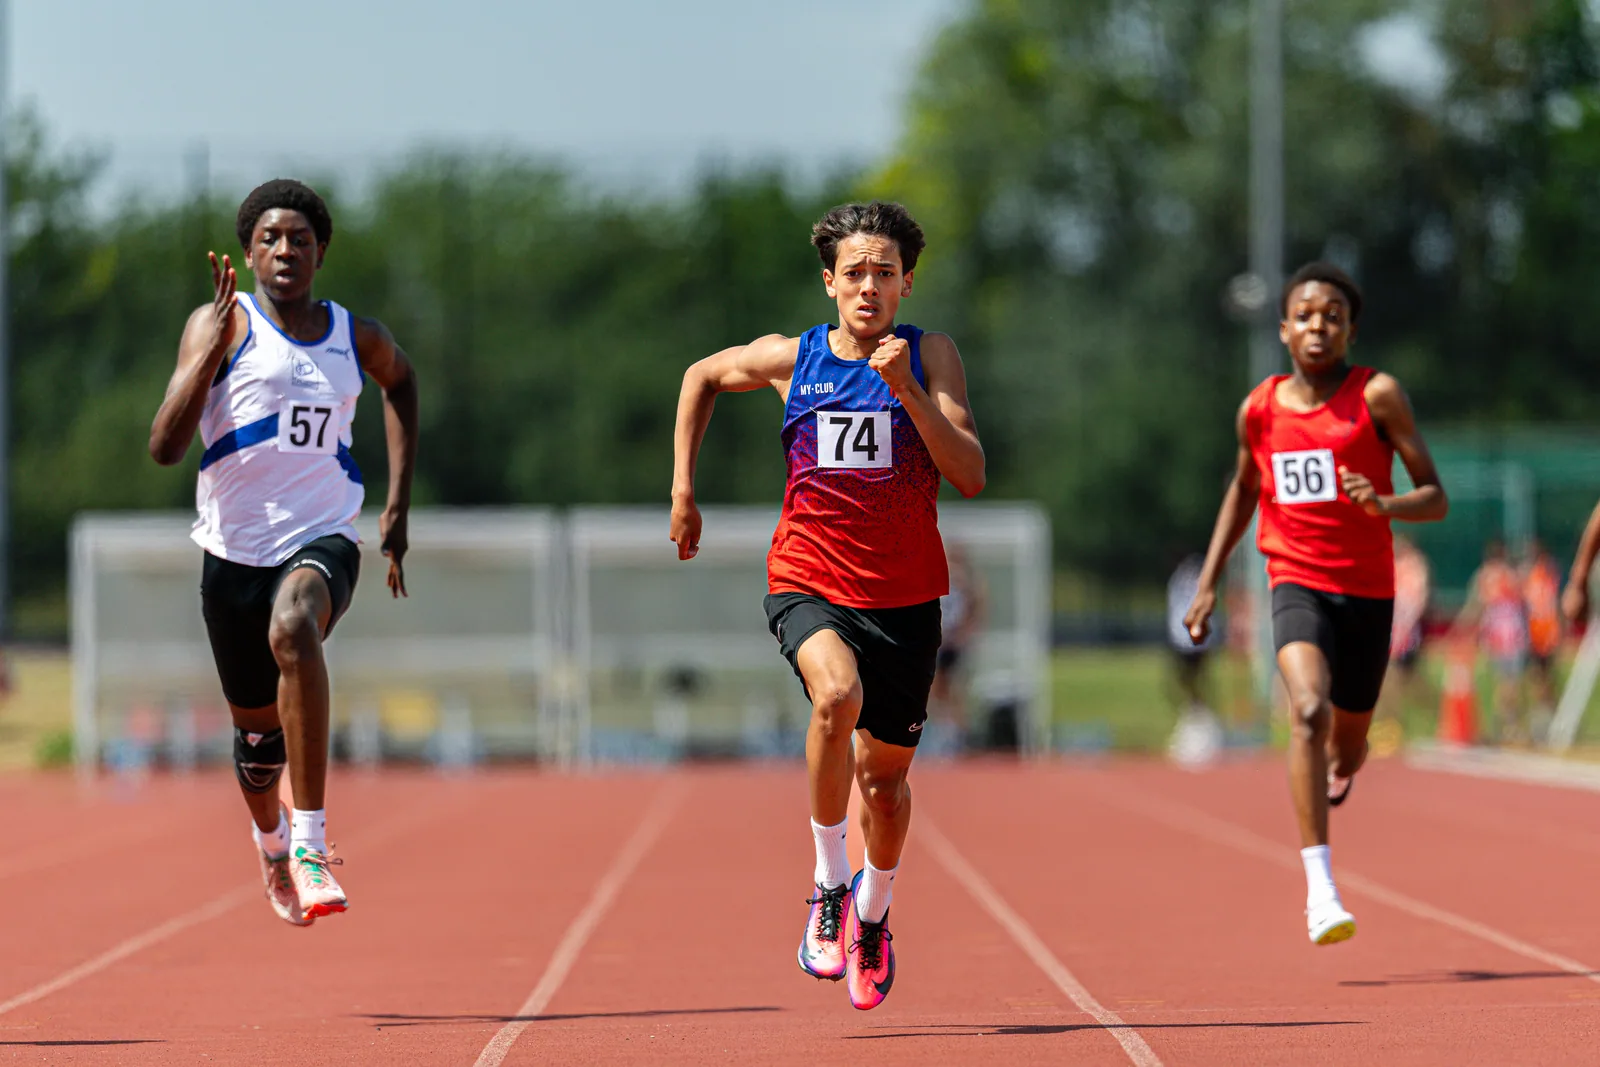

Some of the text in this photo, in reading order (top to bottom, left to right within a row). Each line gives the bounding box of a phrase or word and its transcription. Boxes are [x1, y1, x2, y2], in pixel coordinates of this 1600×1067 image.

[290, 406, 332, 448] 57
[829, 417, 879, 461] 74
[1283, 457, 1323, 496] 56
